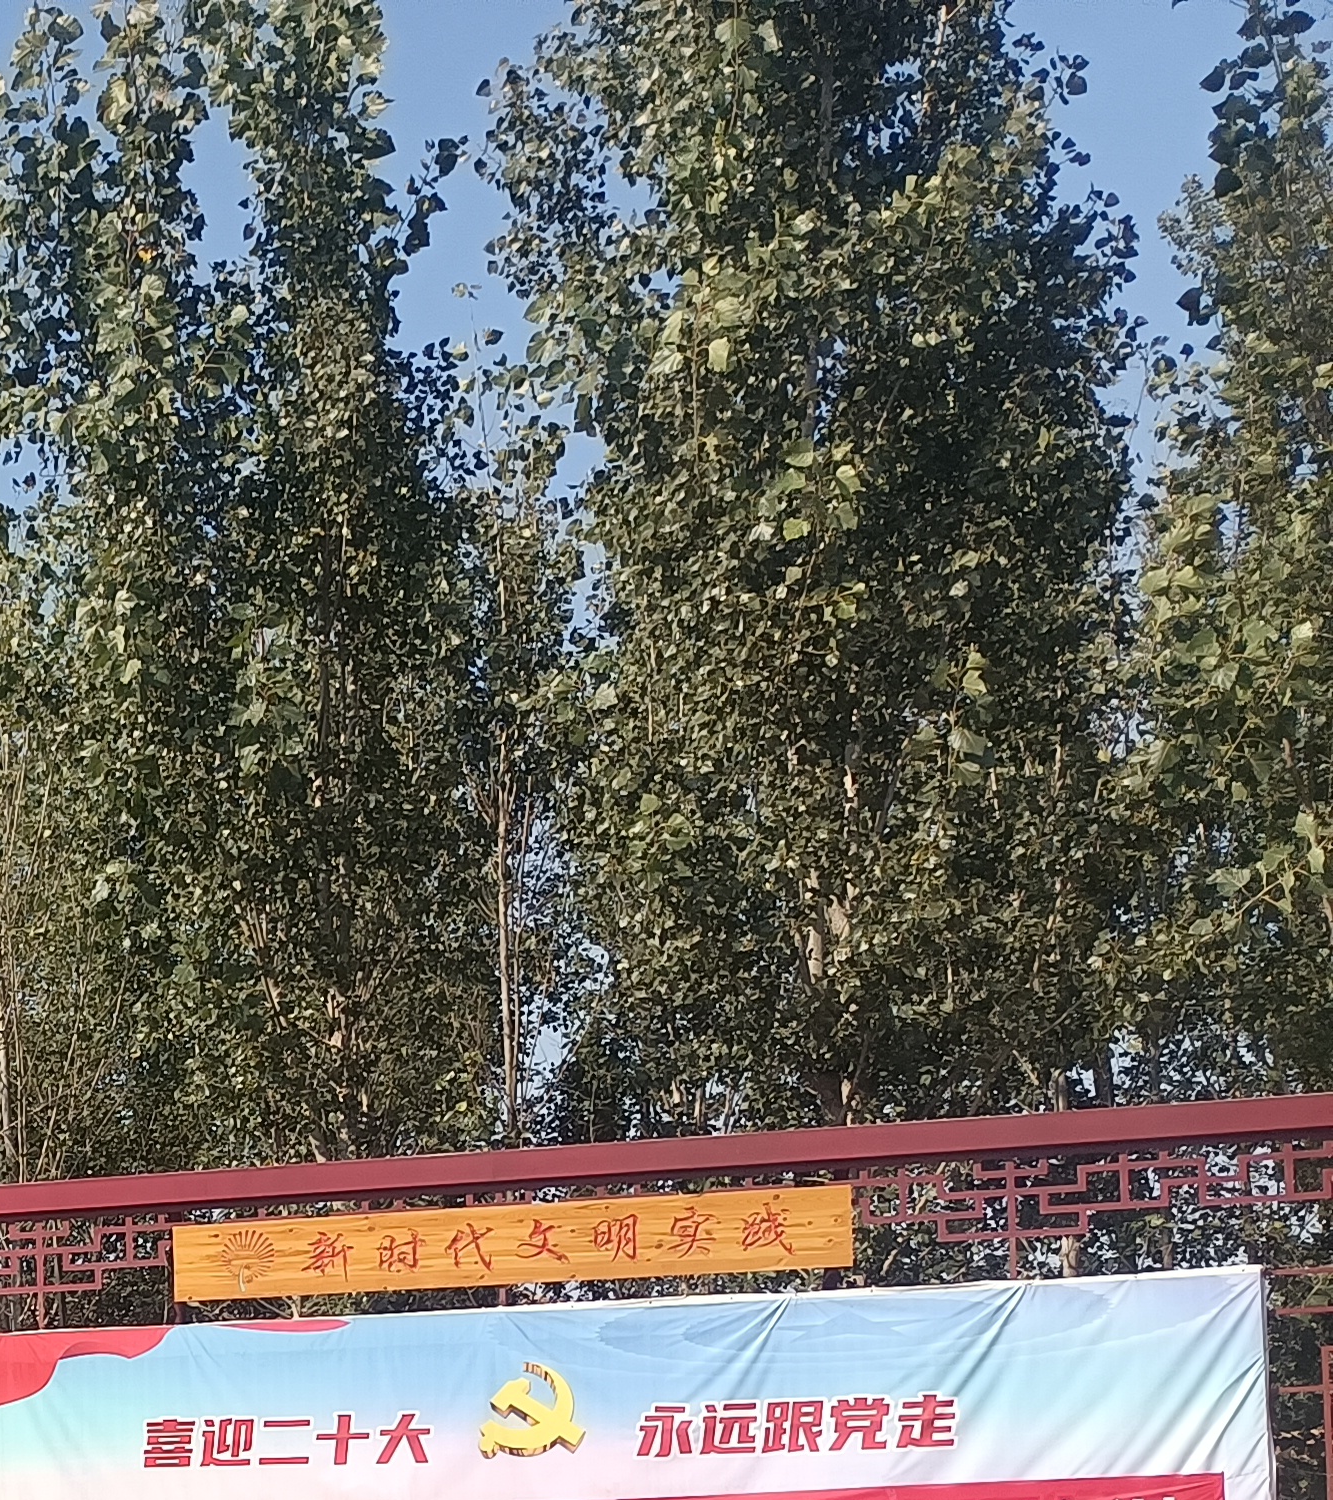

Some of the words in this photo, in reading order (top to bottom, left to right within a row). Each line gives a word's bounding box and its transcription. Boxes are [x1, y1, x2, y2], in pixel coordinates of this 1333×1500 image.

[300, 1203, 796, 1282] 新时代文明实践
[142, 1407, 431, 1469] 喜迎二十大
[637, 1393, 960, 1460] 永远跟党走
